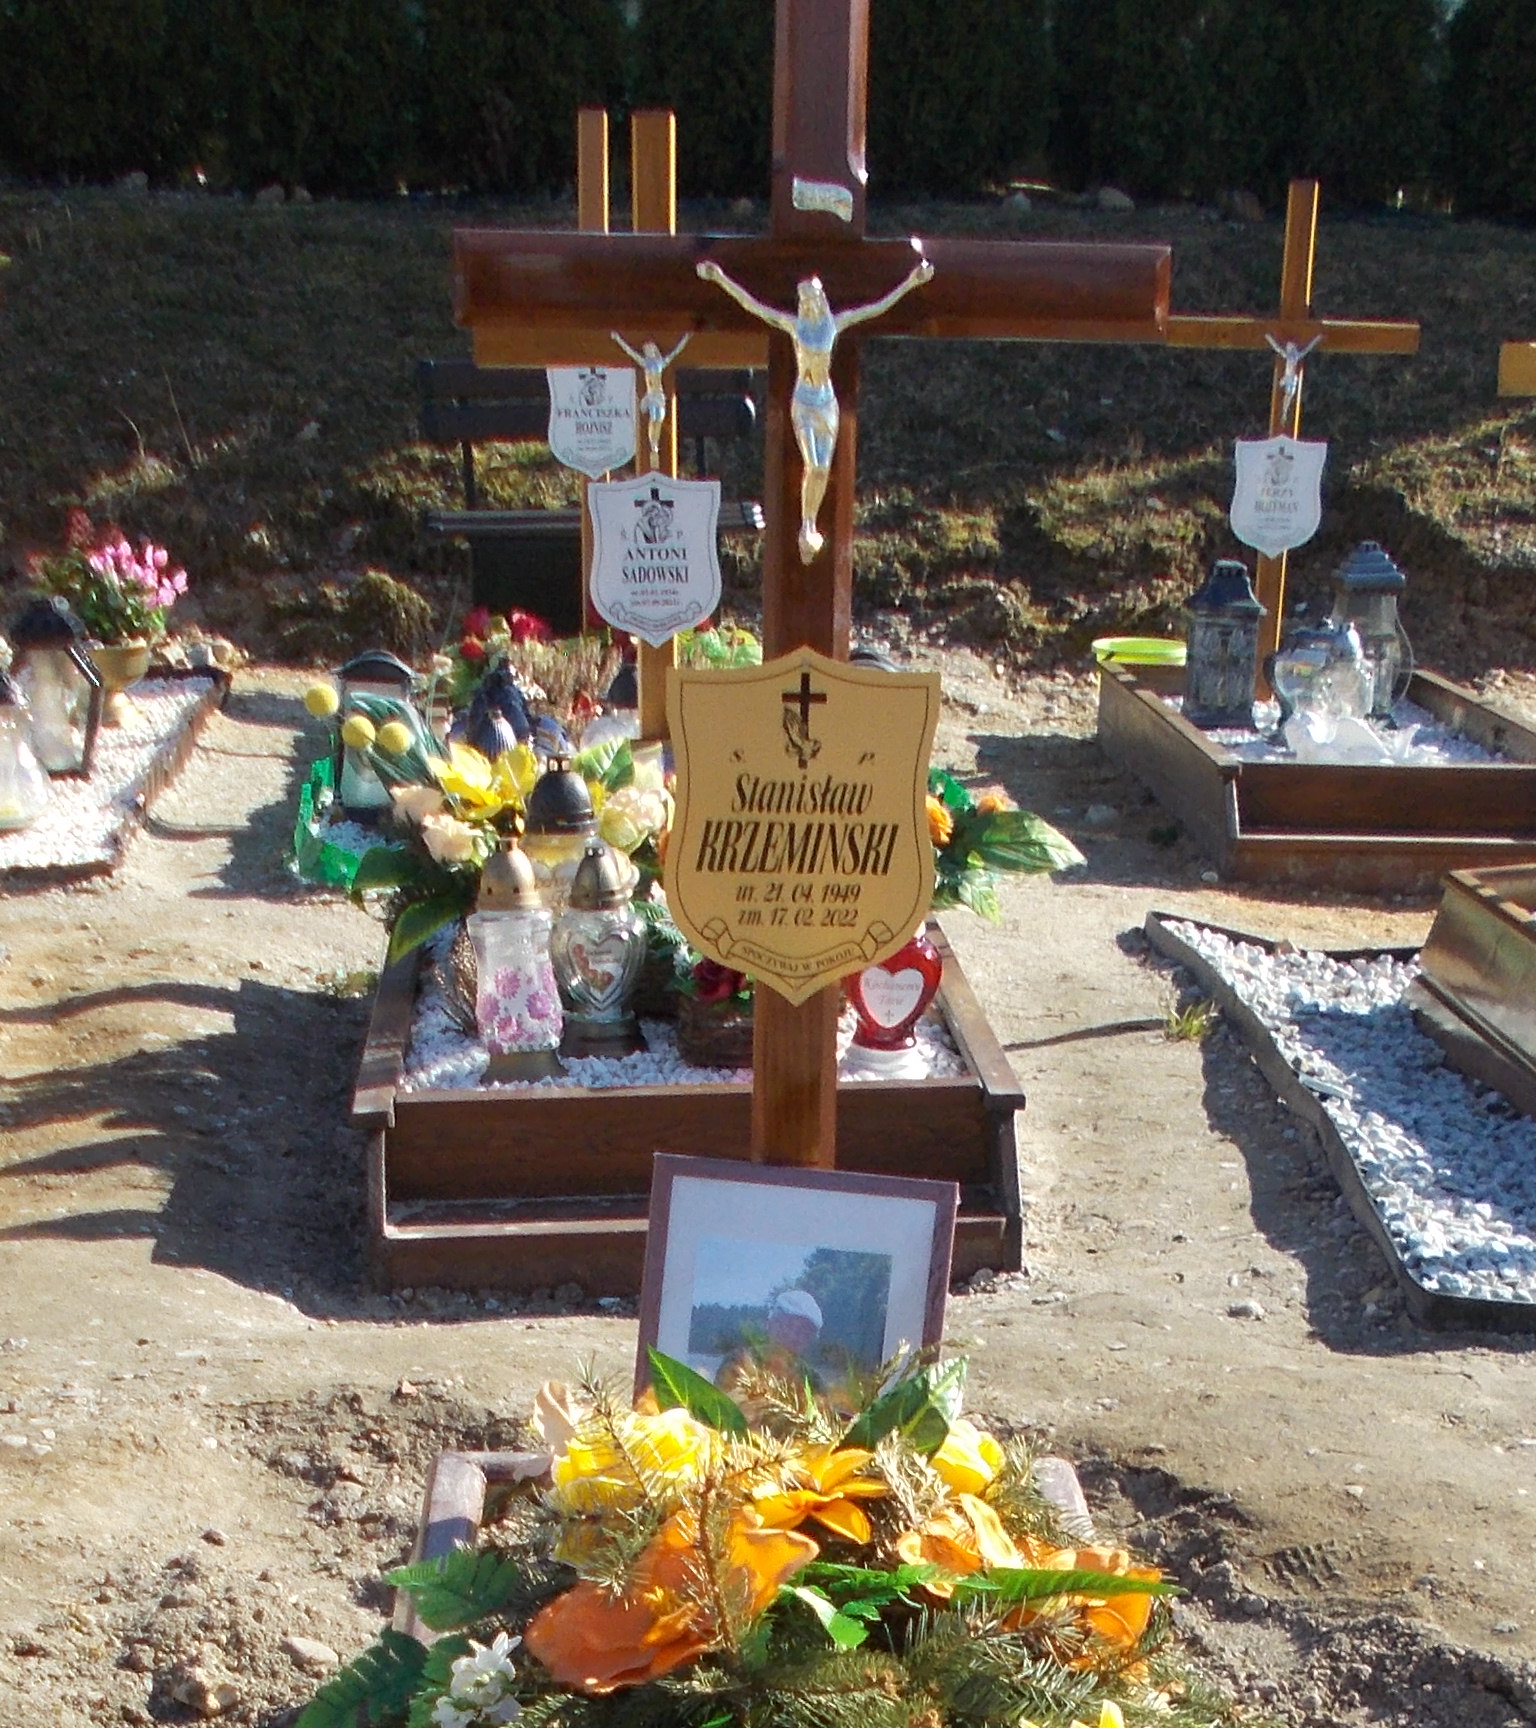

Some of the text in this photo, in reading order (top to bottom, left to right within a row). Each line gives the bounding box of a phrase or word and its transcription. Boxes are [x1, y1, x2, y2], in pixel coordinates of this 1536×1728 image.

[624, 548, 687, 561] ANTONI
[621, 566, 689, 584] SADOWSKI
[731, 771, 874, 816] Stanisław
[821, 883, 862, 904] 1949
[820, 909, 859, 928] 2022
